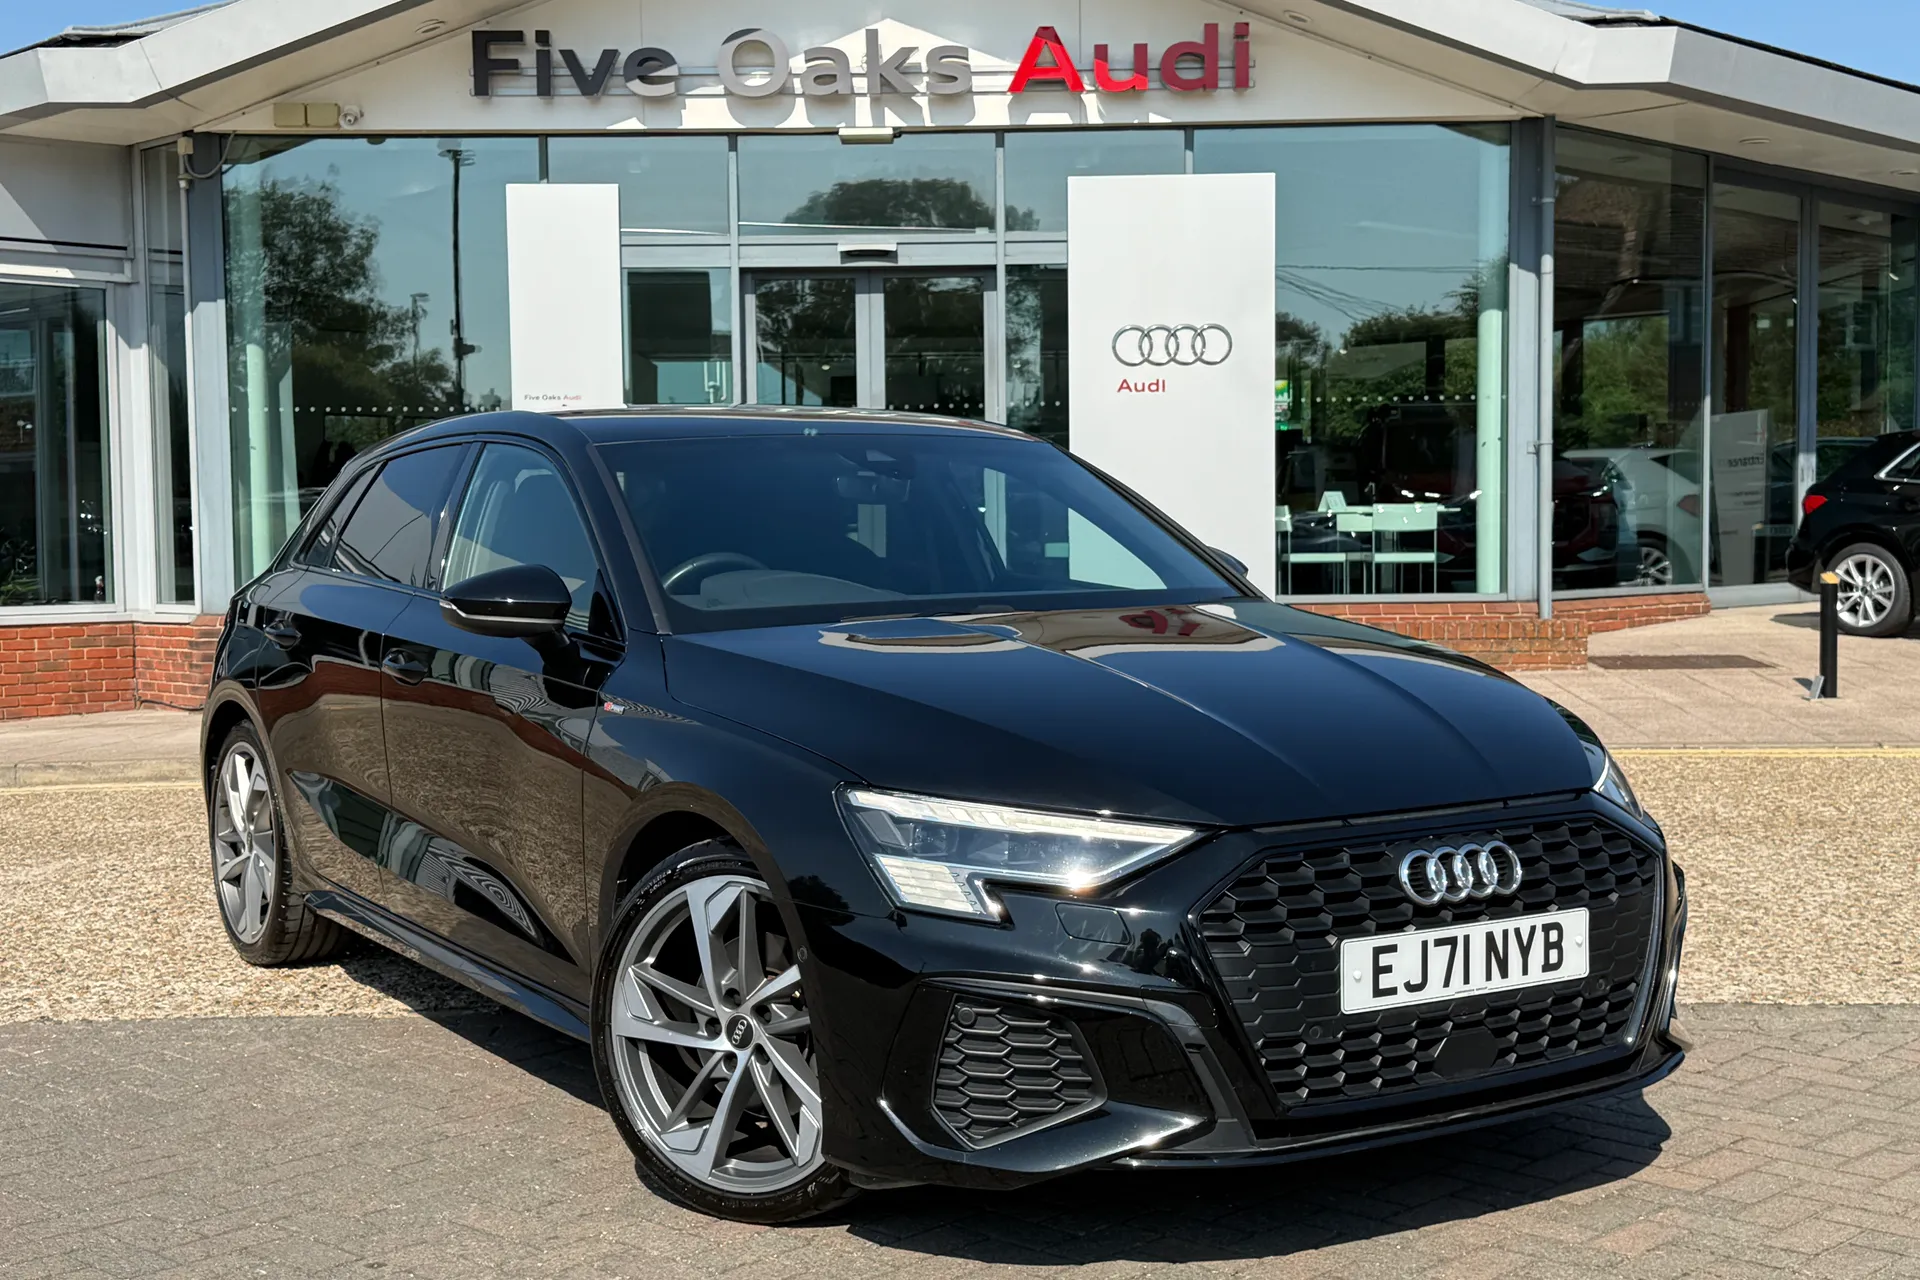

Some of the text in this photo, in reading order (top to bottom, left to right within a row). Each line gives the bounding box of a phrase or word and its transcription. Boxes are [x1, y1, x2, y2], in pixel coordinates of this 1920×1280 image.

[472, 22, 1250, 98] Five Oaks Audi
[1117, 378, 1166, 393] Audi
[1372, 922, 1563, 999] EJ71 NYB
